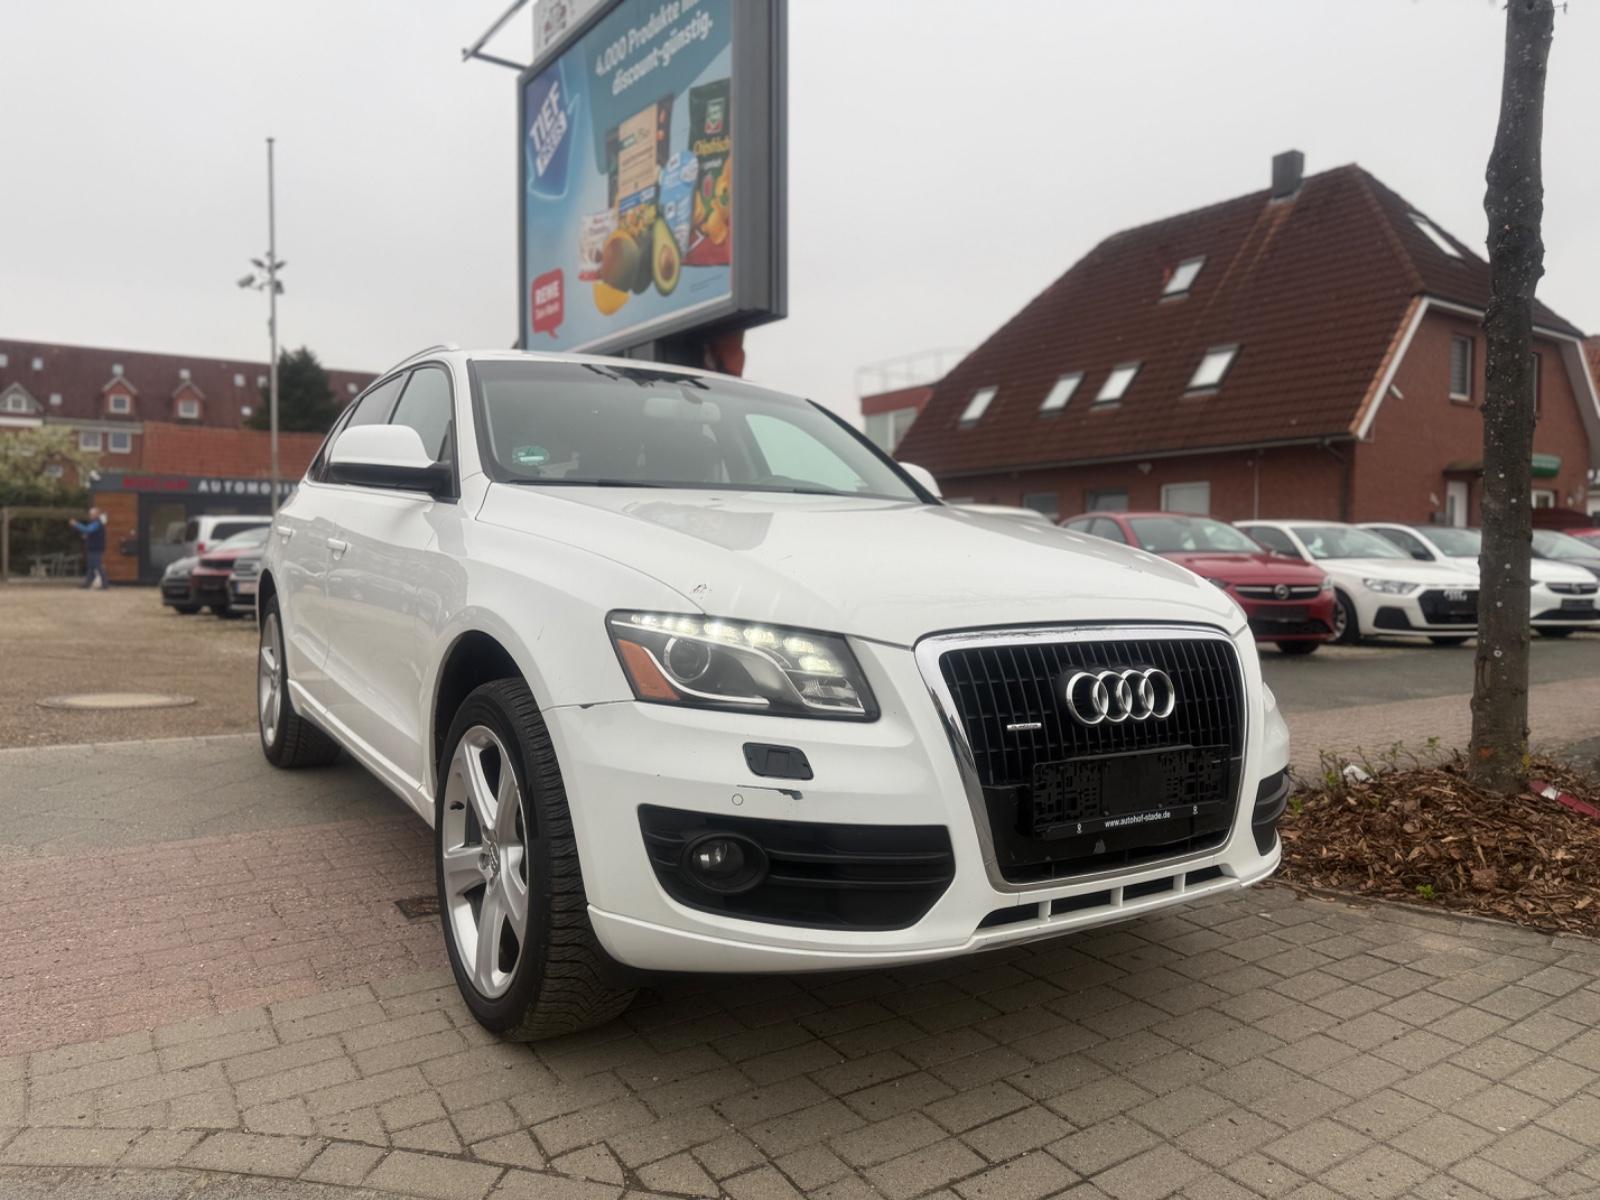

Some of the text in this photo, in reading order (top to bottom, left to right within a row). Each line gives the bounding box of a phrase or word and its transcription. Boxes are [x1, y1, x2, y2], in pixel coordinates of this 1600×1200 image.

[627, 1, 680, 53] Produkte
[528, 80, 560, 152] TIEF
[198, 479, 297, 495] AUTOMOI
[1104, 811, 1171, 829] www.autohof-stade.de
